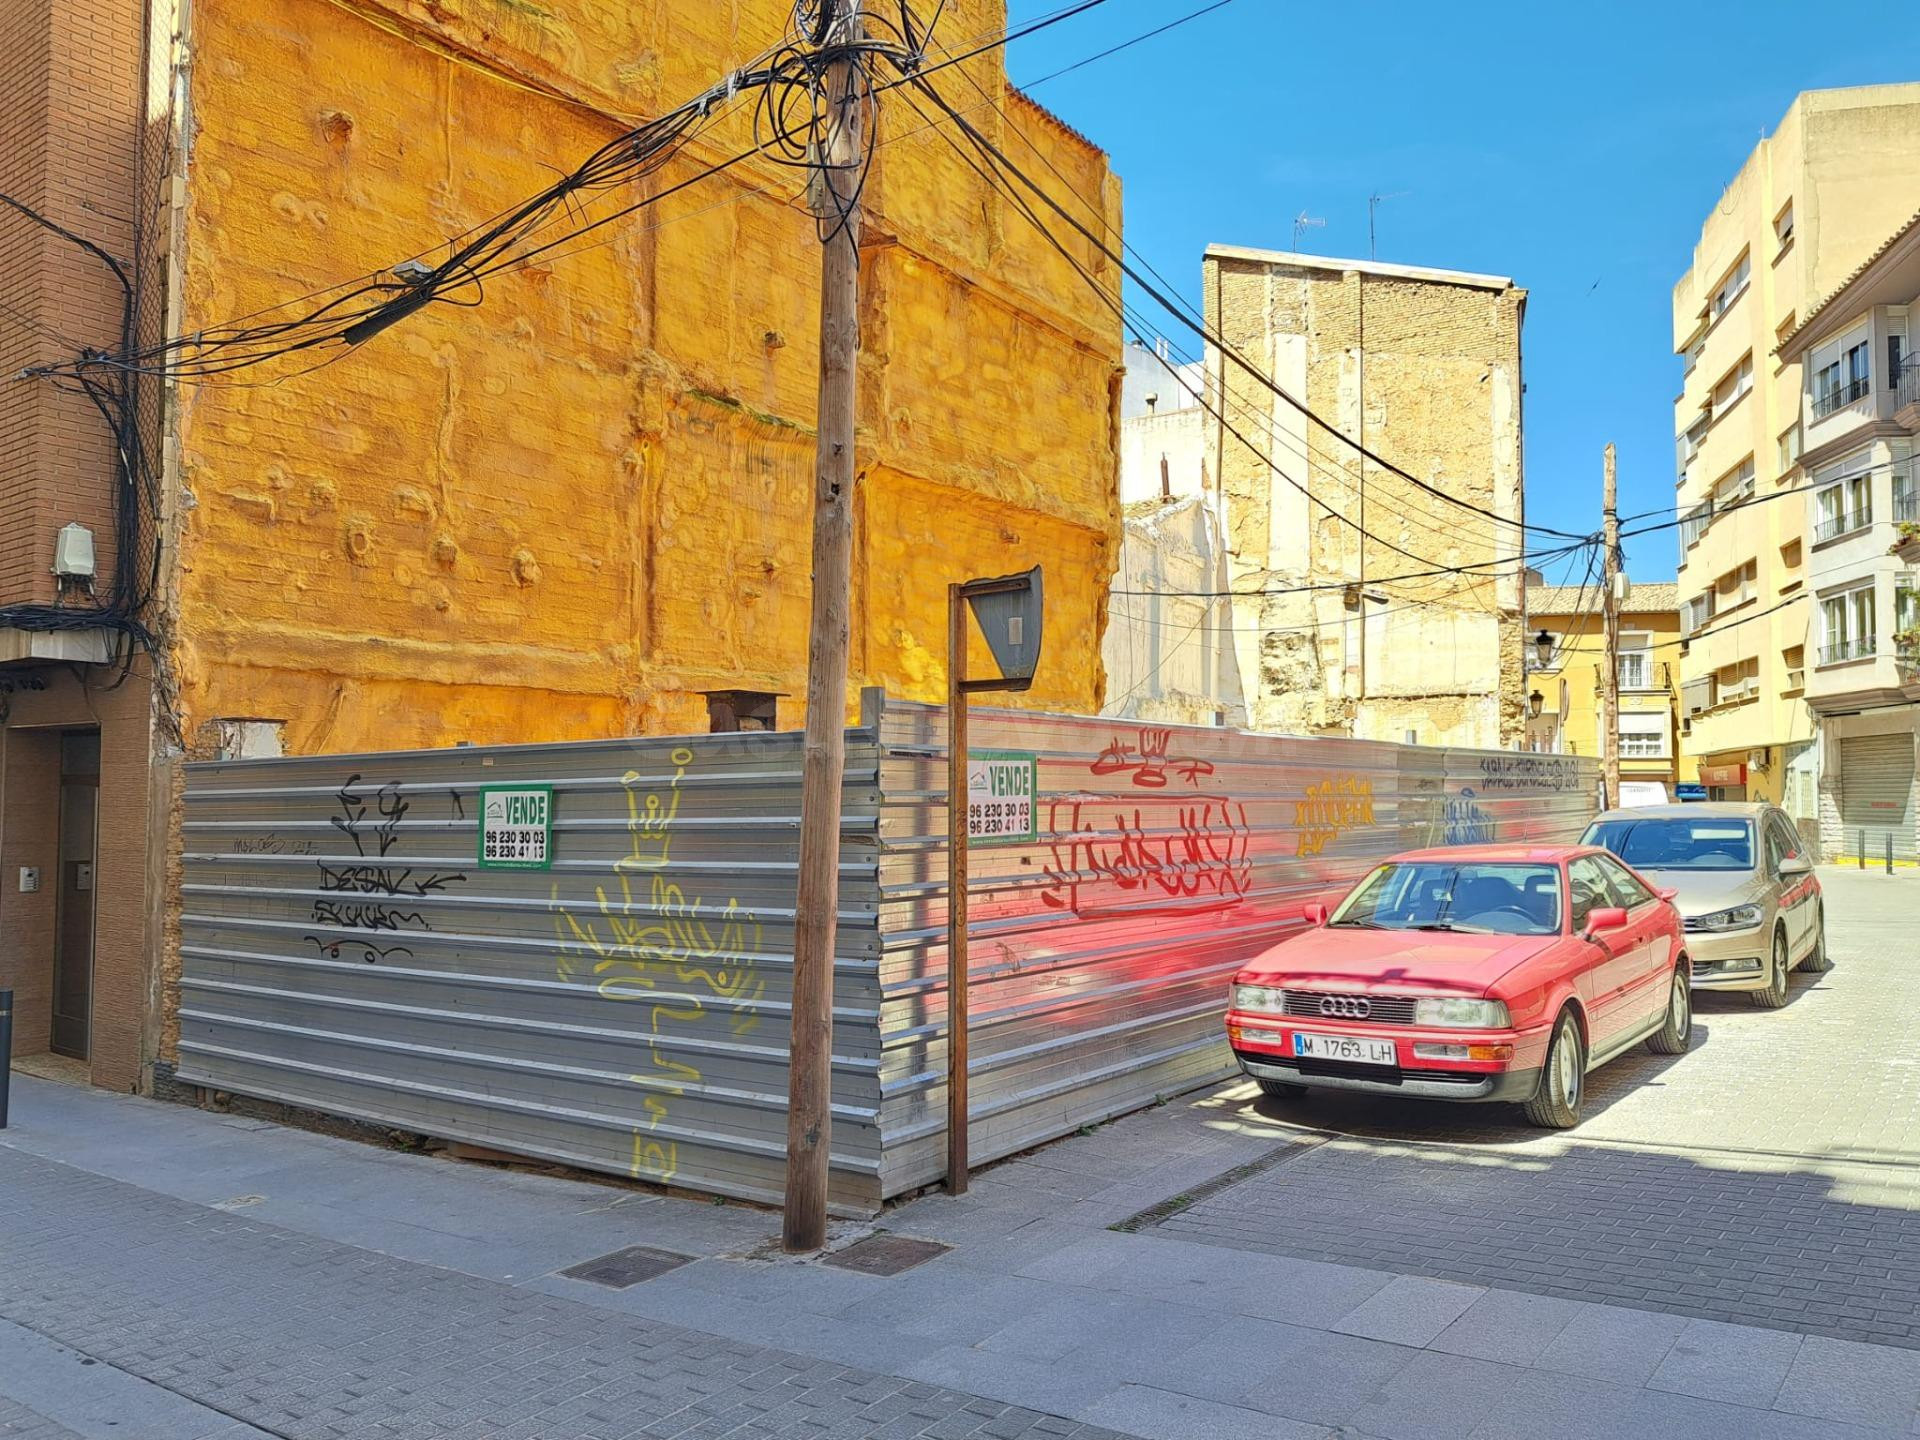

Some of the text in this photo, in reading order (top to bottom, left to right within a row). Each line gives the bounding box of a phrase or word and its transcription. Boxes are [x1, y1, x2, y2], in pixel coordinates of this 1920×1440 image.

[988, 766, 1030, 796] VENDE
[505, 796, 546, 825] VENDE
[969, 802, 1030, 818] 96 230 30 03
[969, 817, 1030, 834] 96 230 41 13
[485, 831, 545, 844] 96 230 30 03
[485, 845, 545, 859] 96 230 41 13
